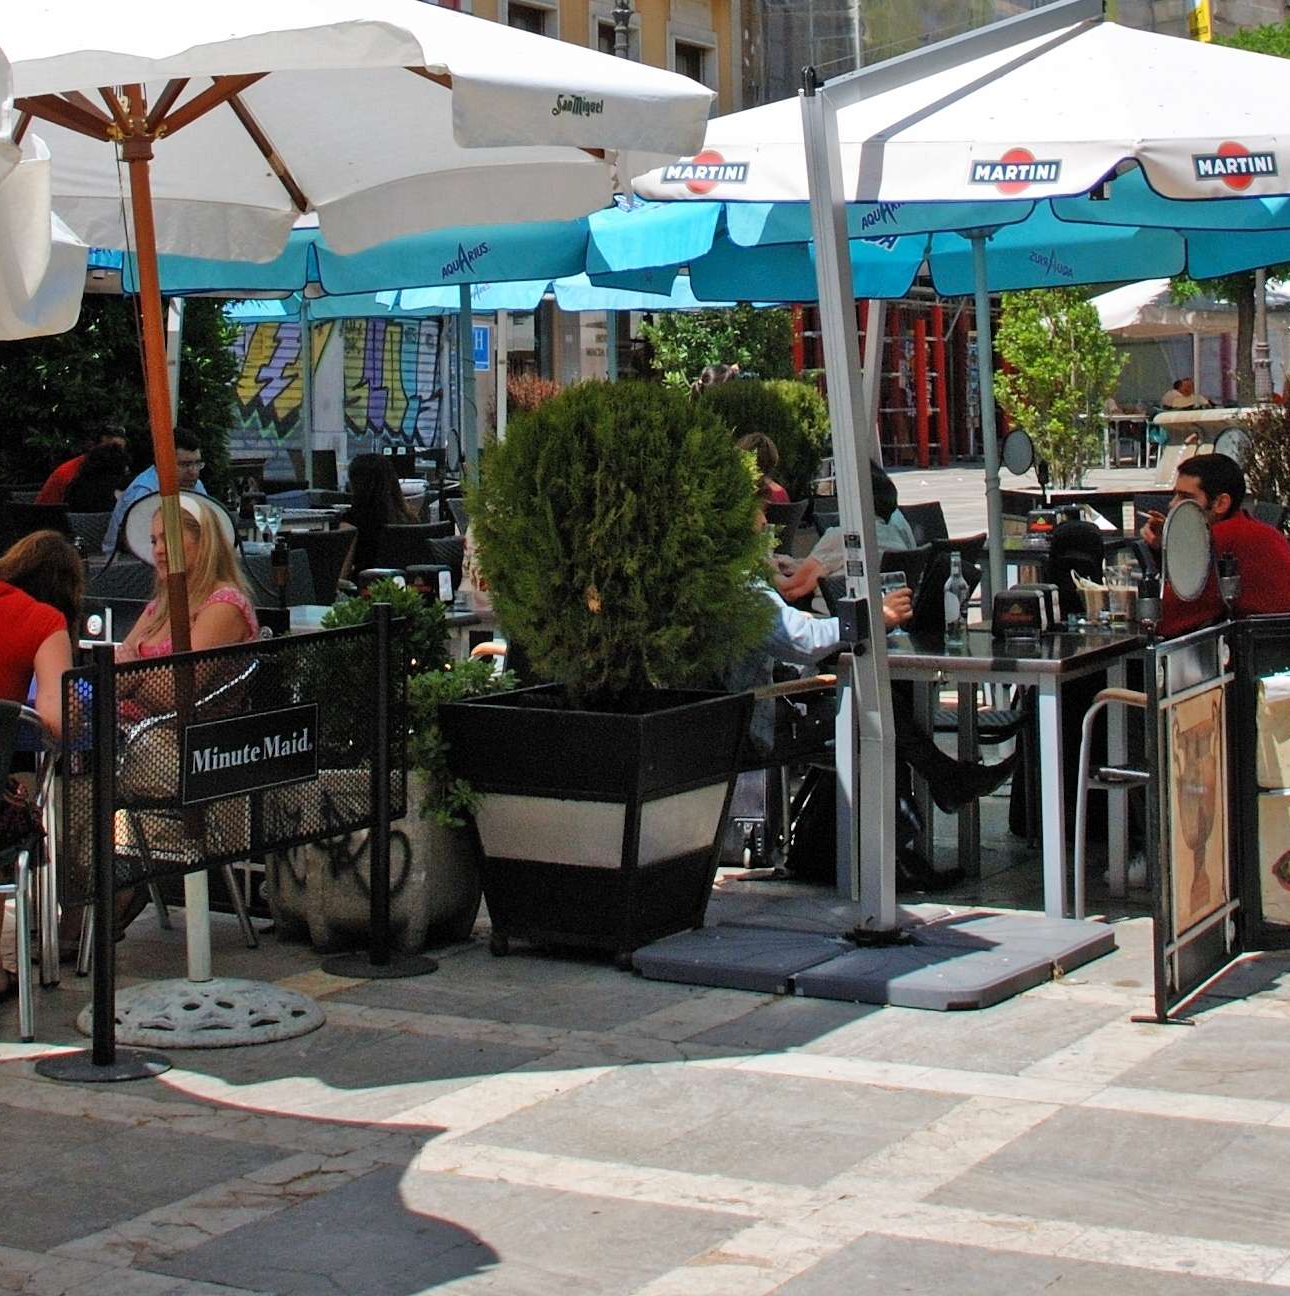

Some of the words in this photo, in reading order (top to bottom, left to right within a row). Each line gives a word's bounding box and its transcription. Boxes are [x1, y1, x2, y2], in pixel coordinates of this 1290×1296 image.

[666, 164, 745, 182] MARTINI
[974, 163, 1057, 182] MARTINI
[1197, 155, 1273, 176] MARTINI
[442, 242, 490, 280] AQUARIUS
[474, 329, 484, 351] H
[191, 743, 261, 775] Minute
[263, 727, 309, 760] Maid
